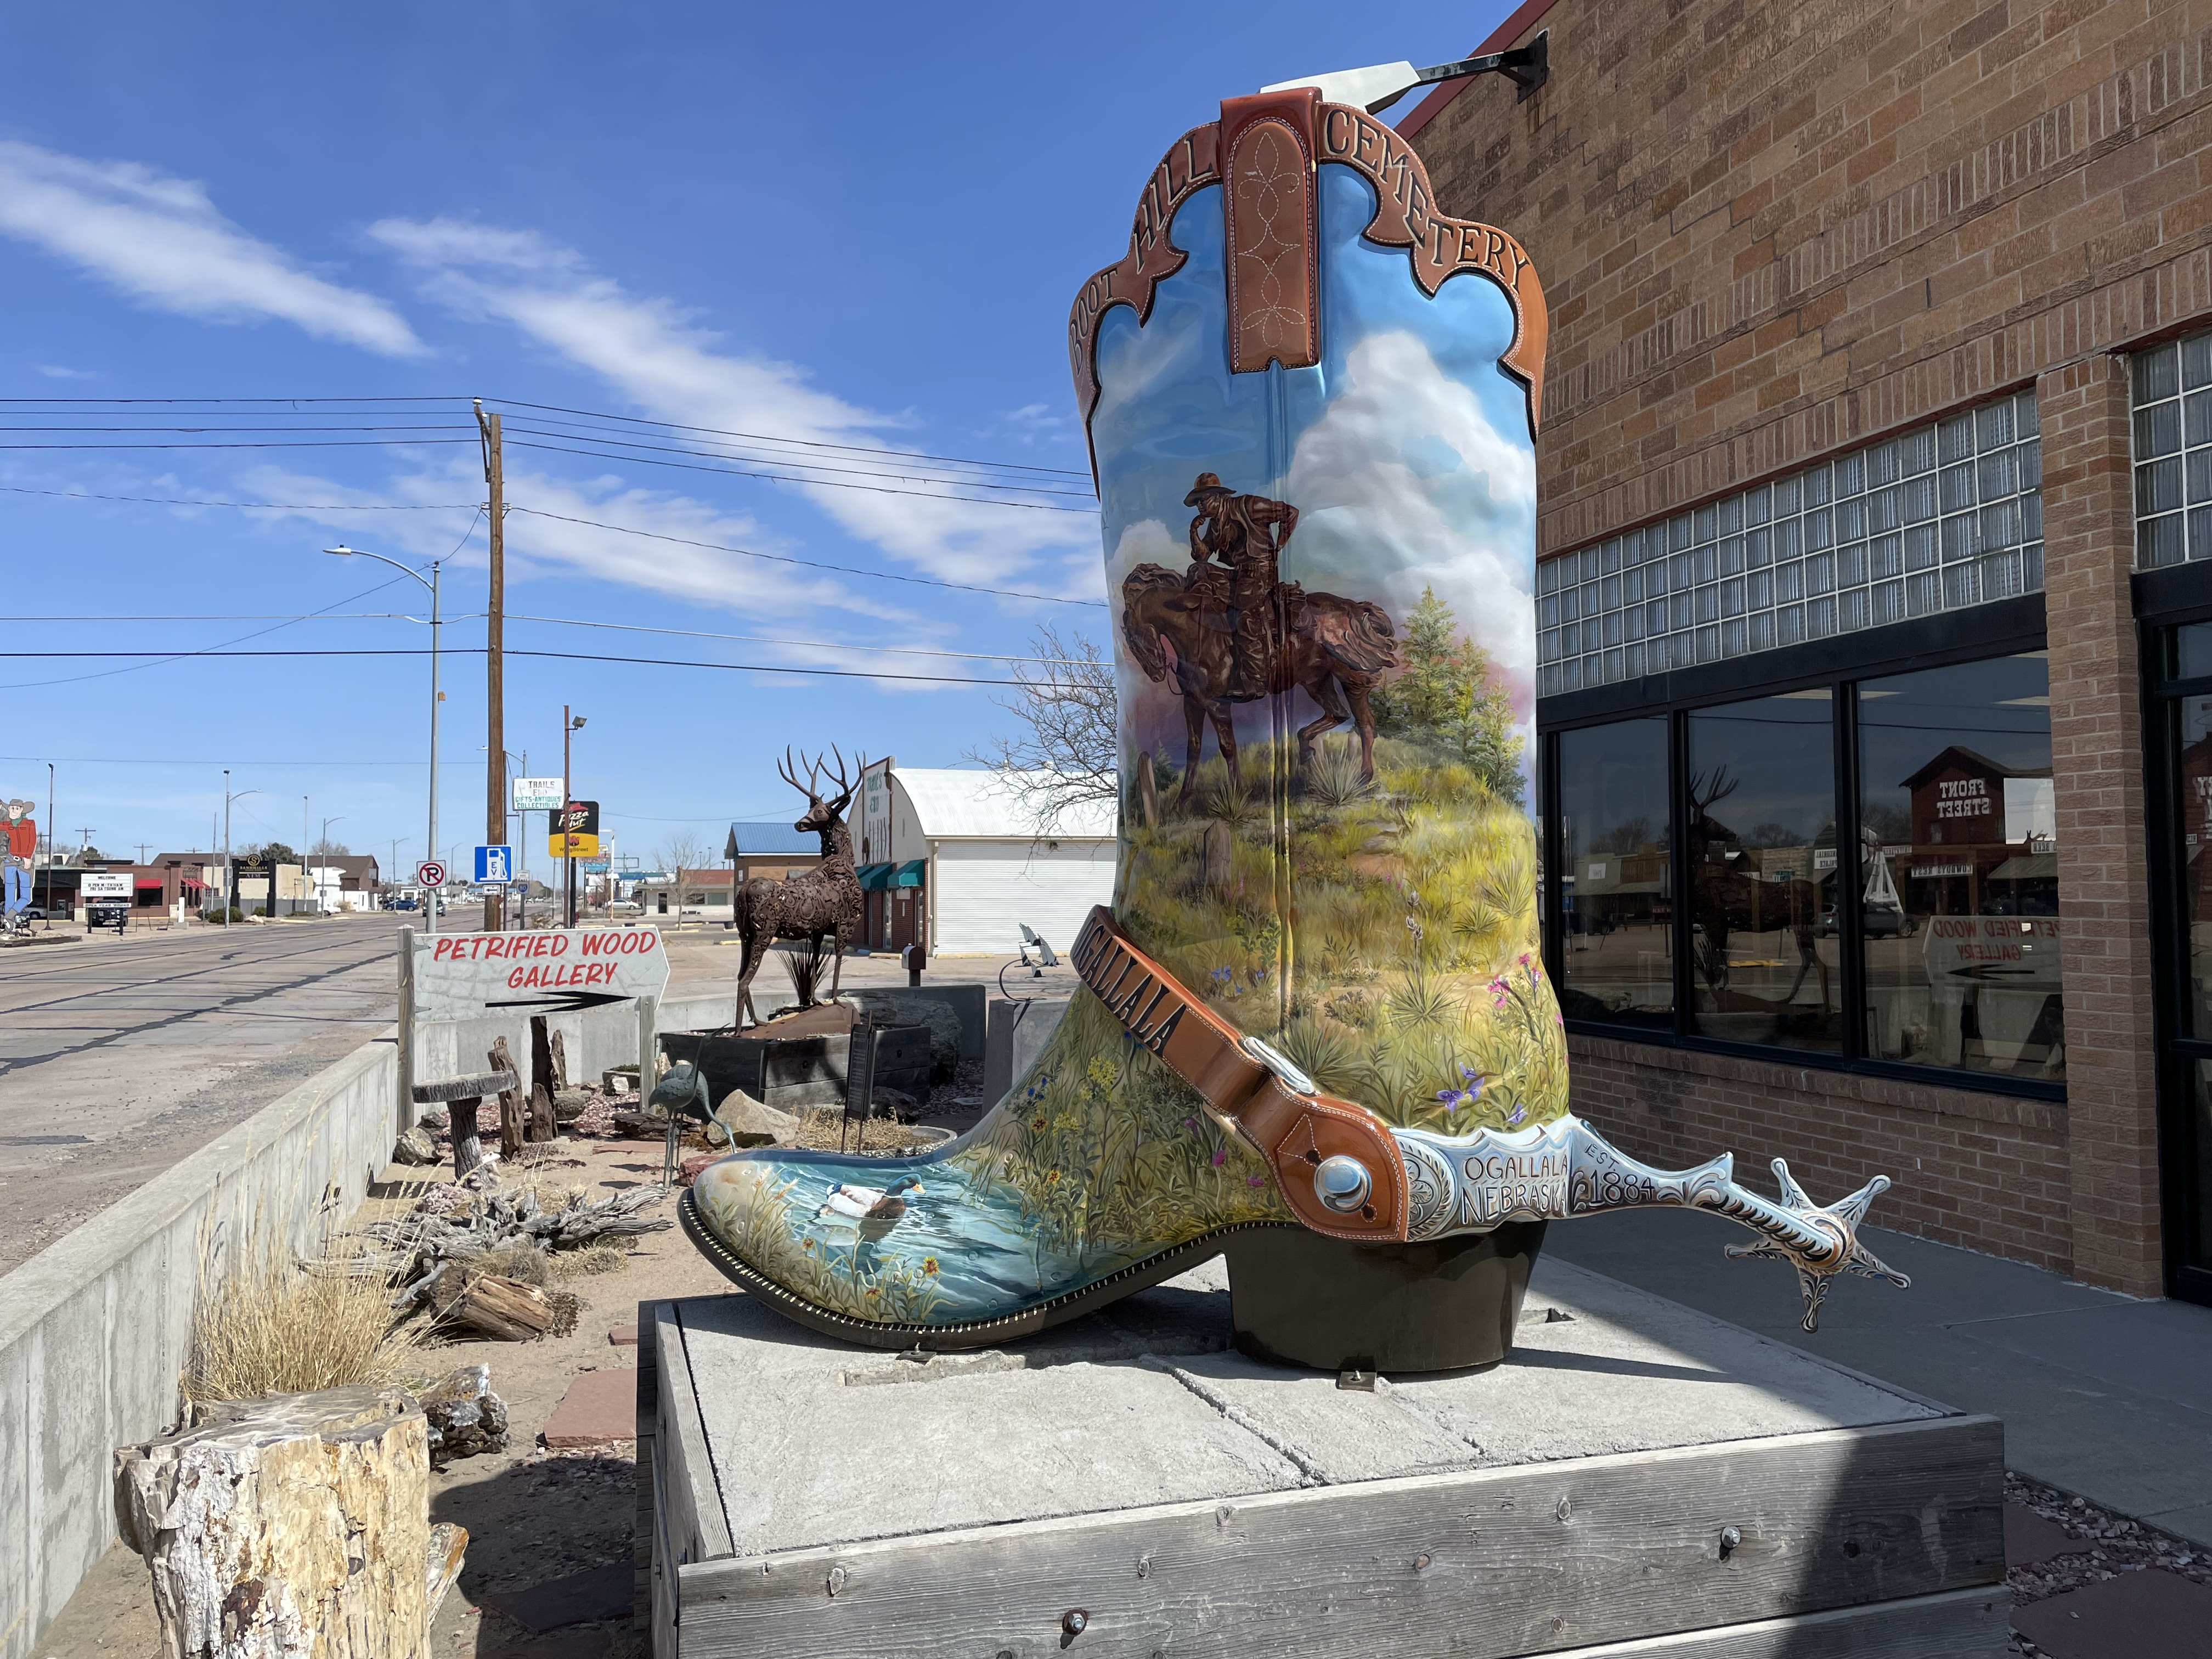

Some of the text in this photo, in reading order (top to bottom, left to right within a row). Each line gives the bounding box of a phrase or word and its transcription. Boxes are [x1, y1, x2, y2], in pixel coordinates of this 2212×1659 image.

[1069, 108, 1531, 379] BOOT HILL CEMETERY
[558, 811, 589, 827] Pzza
[434, 932, 657, 961] PETRIFIED WOOD
[507, 962, 618, 989] GALLERY
[1073, 917, 1187, 1057] OGALLALA
[1463, 1154, 1568, 1183] OGALLALA
[1460, 1180, 1568, 1224] NEBRASKA
[1589, 1169, 1654, 1208] 1884
